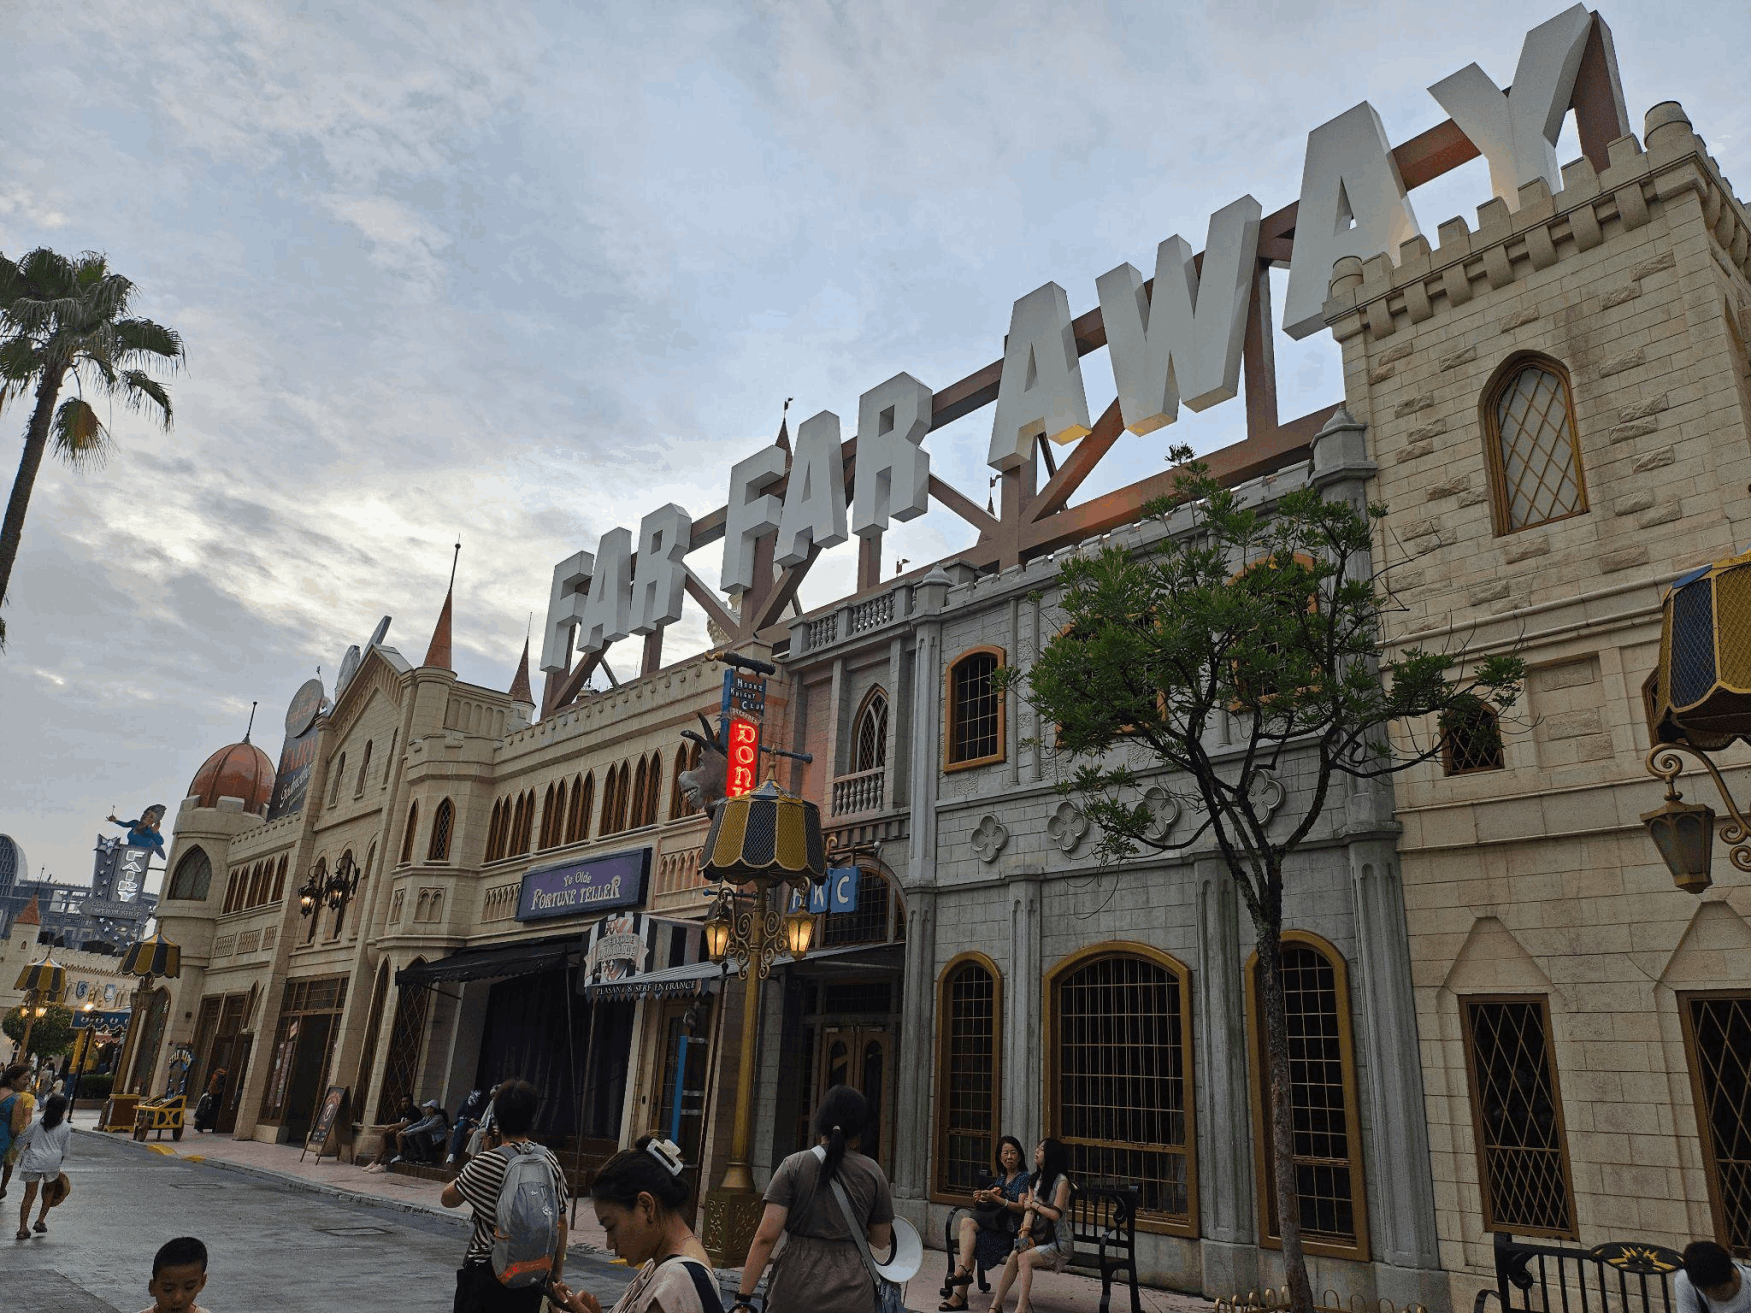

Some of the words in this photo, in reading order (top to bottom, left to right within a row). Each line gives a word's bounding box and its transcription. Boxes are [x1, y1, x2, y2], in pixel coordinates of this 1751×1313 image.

[540, 502, 692, 673] FAR
[720, 372, 933, 595] FAR
[986, 2, 1595, 473] AWAY
[730, 687, 756, 699] KNIGHT
[117, 850, 146, 902] FAIRY
[563, 875, 573, 888] Ye
[575, 871, 592, 884] Olde
[530, 888, 577, 911] FORTUNE
[579, 875, 622, 904] TELLER
[635, 982, 652, 993] SERF
[654, 979, 696, 991] ENTRANCE
